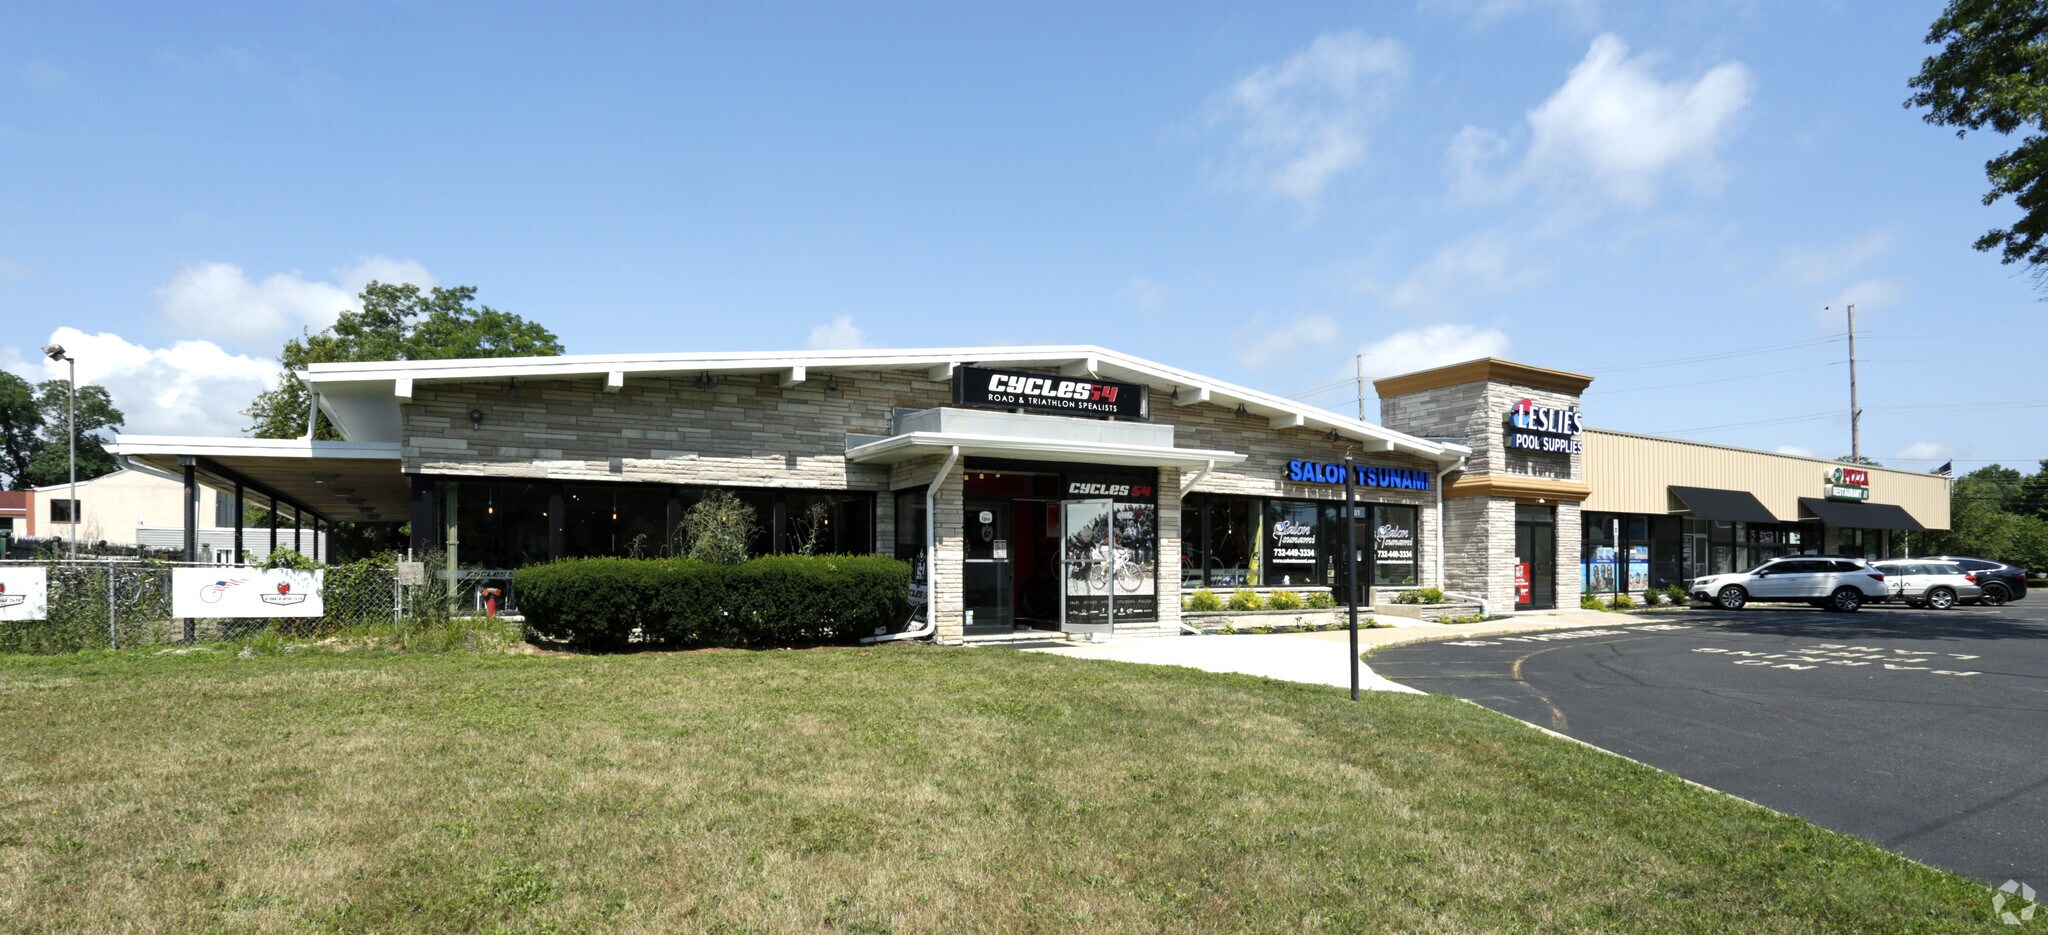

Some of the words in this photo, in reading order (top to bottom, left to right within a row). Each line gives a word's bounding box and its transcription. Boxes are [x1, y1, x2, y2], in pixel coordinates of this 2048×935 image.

[988, 394, 1015, 404] ROAD
[1029, 397, 1075, 408] TRIATHLON
[1078, 401, 1118, 412] SPEALISTS
[1518, 403, 1583, 436] LESLIE'S
[1516, 433, 1540, 450] POOL
[1543, 436, 1583, 455] SUPPLIES
[1290, 459, 1348, 485] SALON
[1356, 465, 1430, 490] TSUNAMI
[1843, 468, 1869, 486] PIZZA
[1069, 482, 1130, 496] CYCLES
[1130, 485, 1152, 497] 54
[1274, 549, 1315, 557] 732-449-3334
